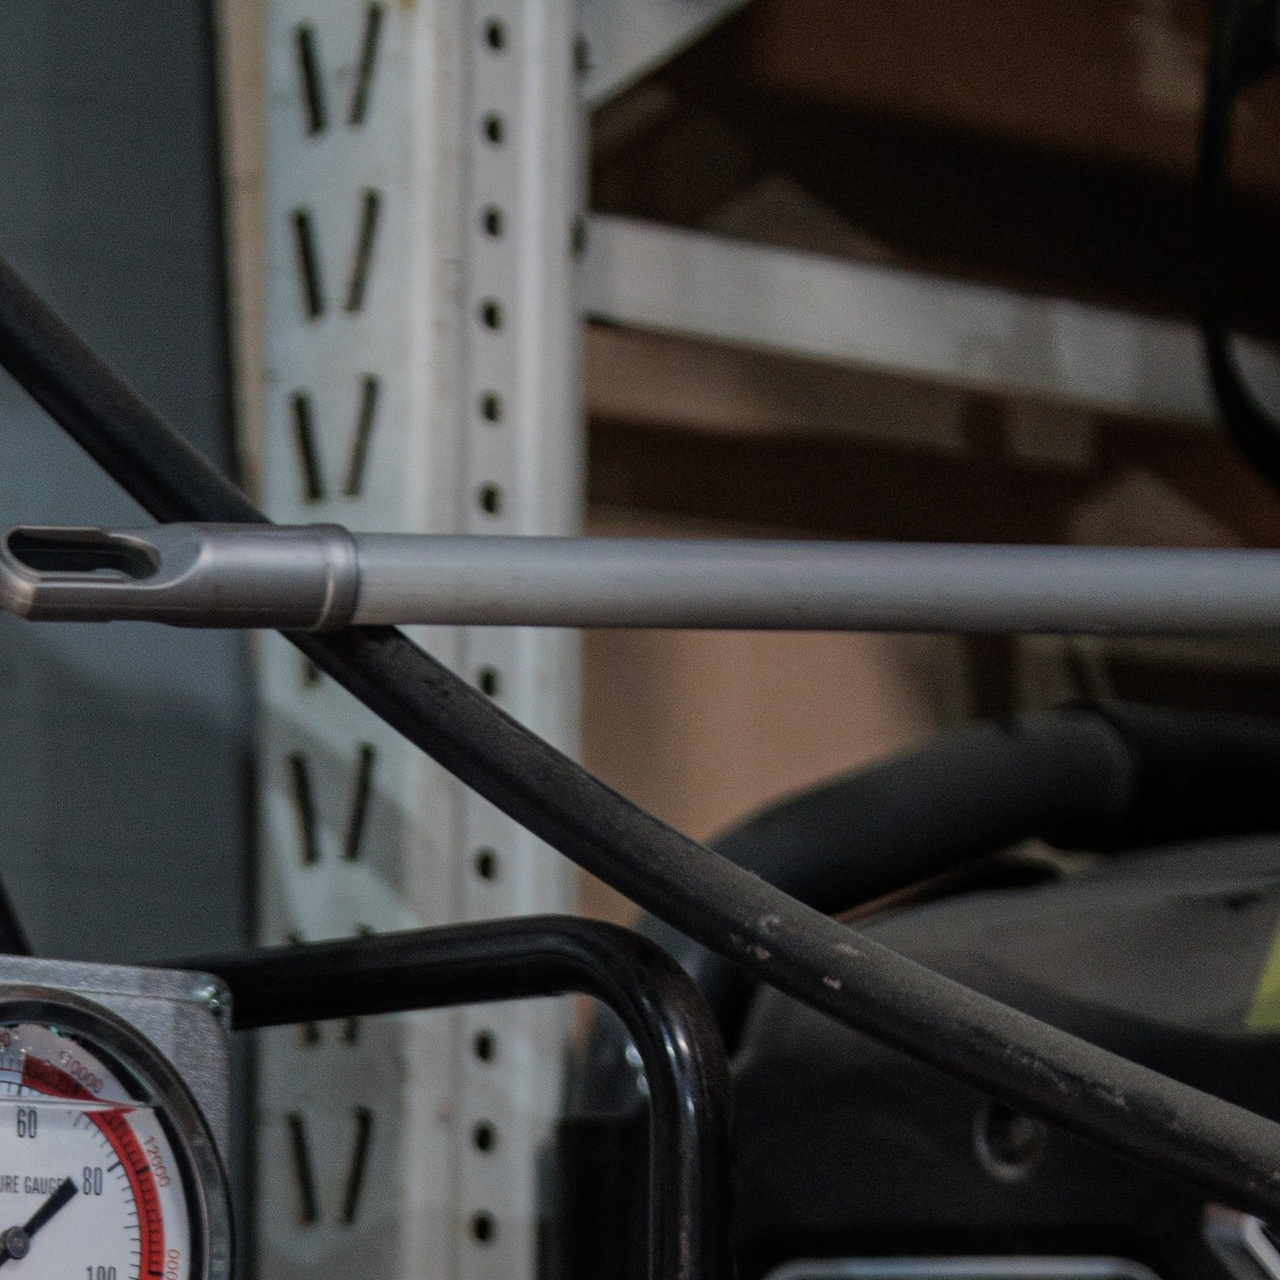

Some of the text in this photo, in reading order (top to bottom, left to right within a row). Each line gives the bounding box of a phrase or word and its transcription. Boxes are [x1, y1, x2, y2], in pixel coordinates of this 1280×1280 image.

[16, 1109, 38, 1139] 60
[143, 1134, 171, 1188] 12000
[82, 1166, 104, 1196] 80
